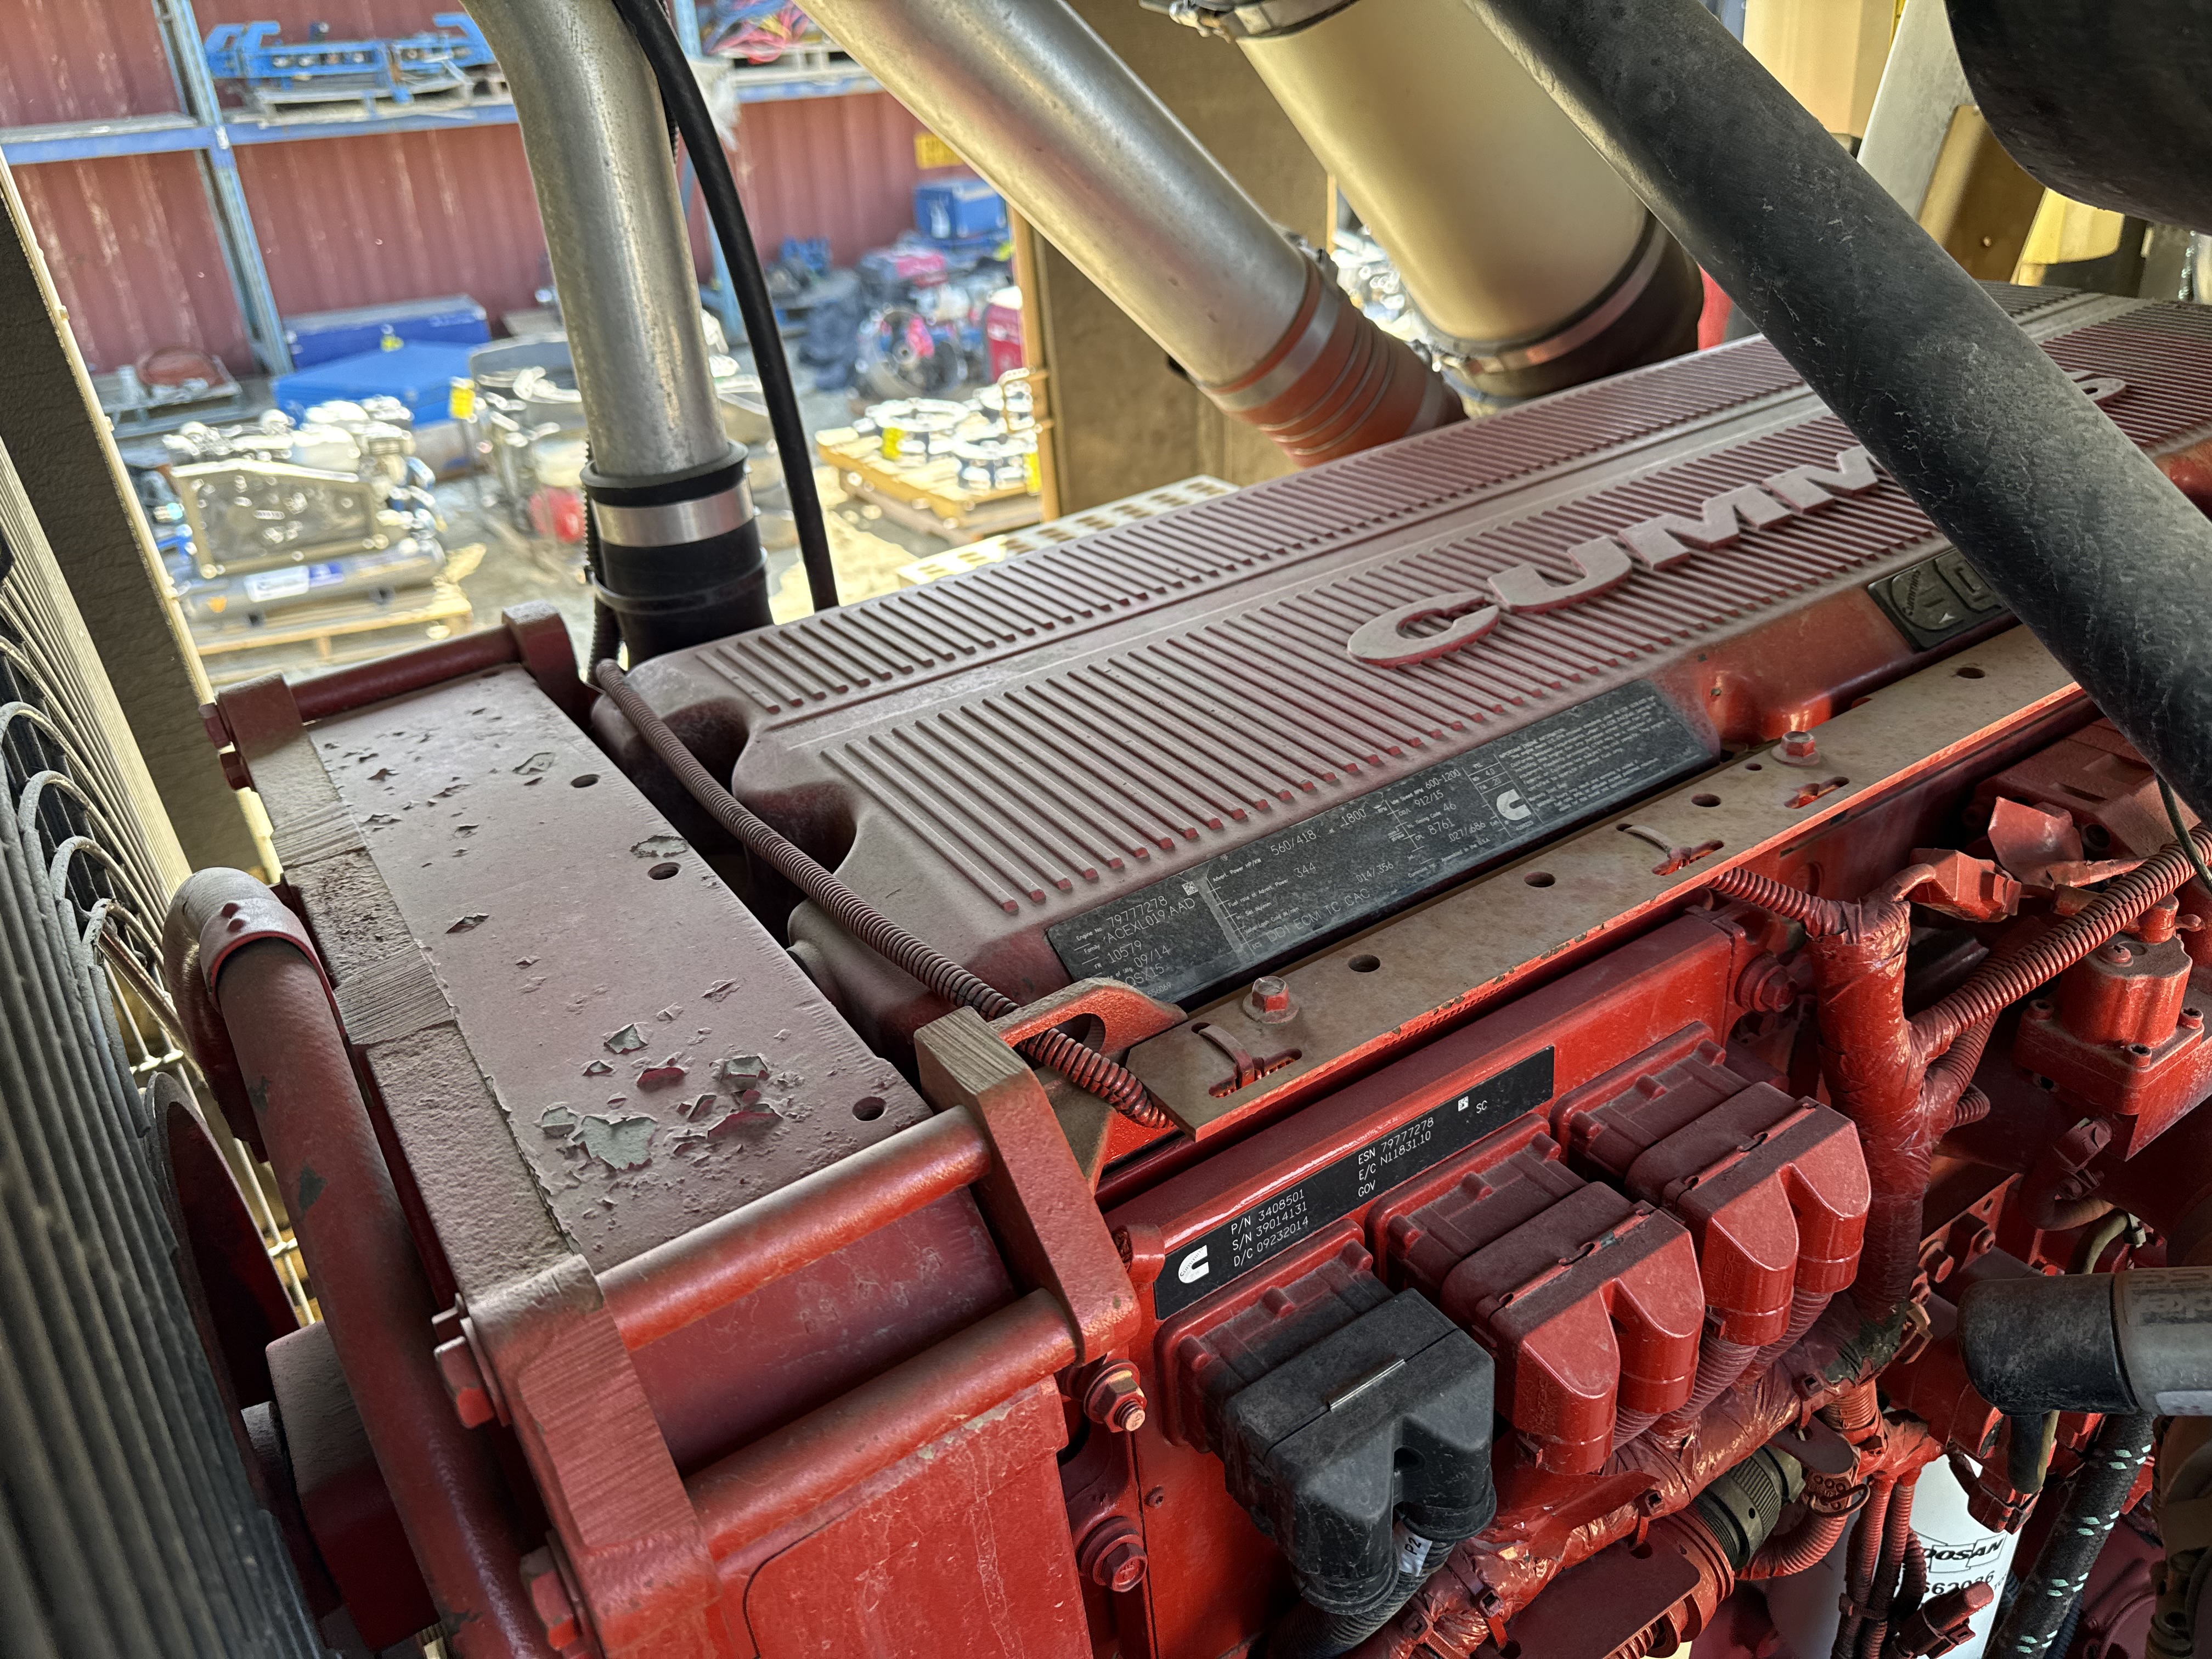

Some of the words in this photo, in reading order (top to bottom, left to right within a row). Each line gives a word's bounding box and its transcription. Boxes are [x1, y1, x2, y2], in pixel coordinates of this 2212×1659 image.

[1423, 768, 1462, 789] 600-1200
[1413, 789, 1445, 808] 912/15
[1440, 799, 1458, 813] 46
[1425, 816, 1455, 836] 8761
[1228, 865, 1245, 874] Power
[1268, 829, 1318, 856] 560/418
[1227, 900, 1239, 908] Fuel
[1274, 877, 1290, 887] Power
[1292, 861, 1318, 878] 344
[1075, 930, 1094, 941] Engine
[1105, 895, 1169, 928] 79777278
[1265, 924, 1291, 942] DDI
[1291, 910, 1323, 930] ECM
[1323, 900, 1342, 916] TC
[1342, 888, 1372, 906] CAC
[1082, 943, 1102, 955] Family
[1104, 939, 1146, 963] 10579
[1132, 944, 1172, 968] 09/14
[1123, 962, 1167, 988] QSX15
[1476, 1100, 1488, 1113] SC
[1358, 1147, 1376, 1165] ESN
[1381, 1116, 1434, 1153] 79777278
[1358, 1162, 1377, 1181] E/C
[1380, 1131, 1432, 1166] N11831.10
[1358, 1180, 1376, 1198] GOV
[1231, 1215, 1251, 1235] P/N
[1257, 1188, 1305, 1222] 3408501
[1232, 1231, 1252, 1251] S/N
[1256, 1201, 1308, 1237] 39014131
[1234, 1248, 1254, 1267] D/C
[1256, 1216, 1309, 1252] 09232014
[1404, 1537, 1421, 1555] P2
[1923, 1538, 2004, 1560] OOSAN
